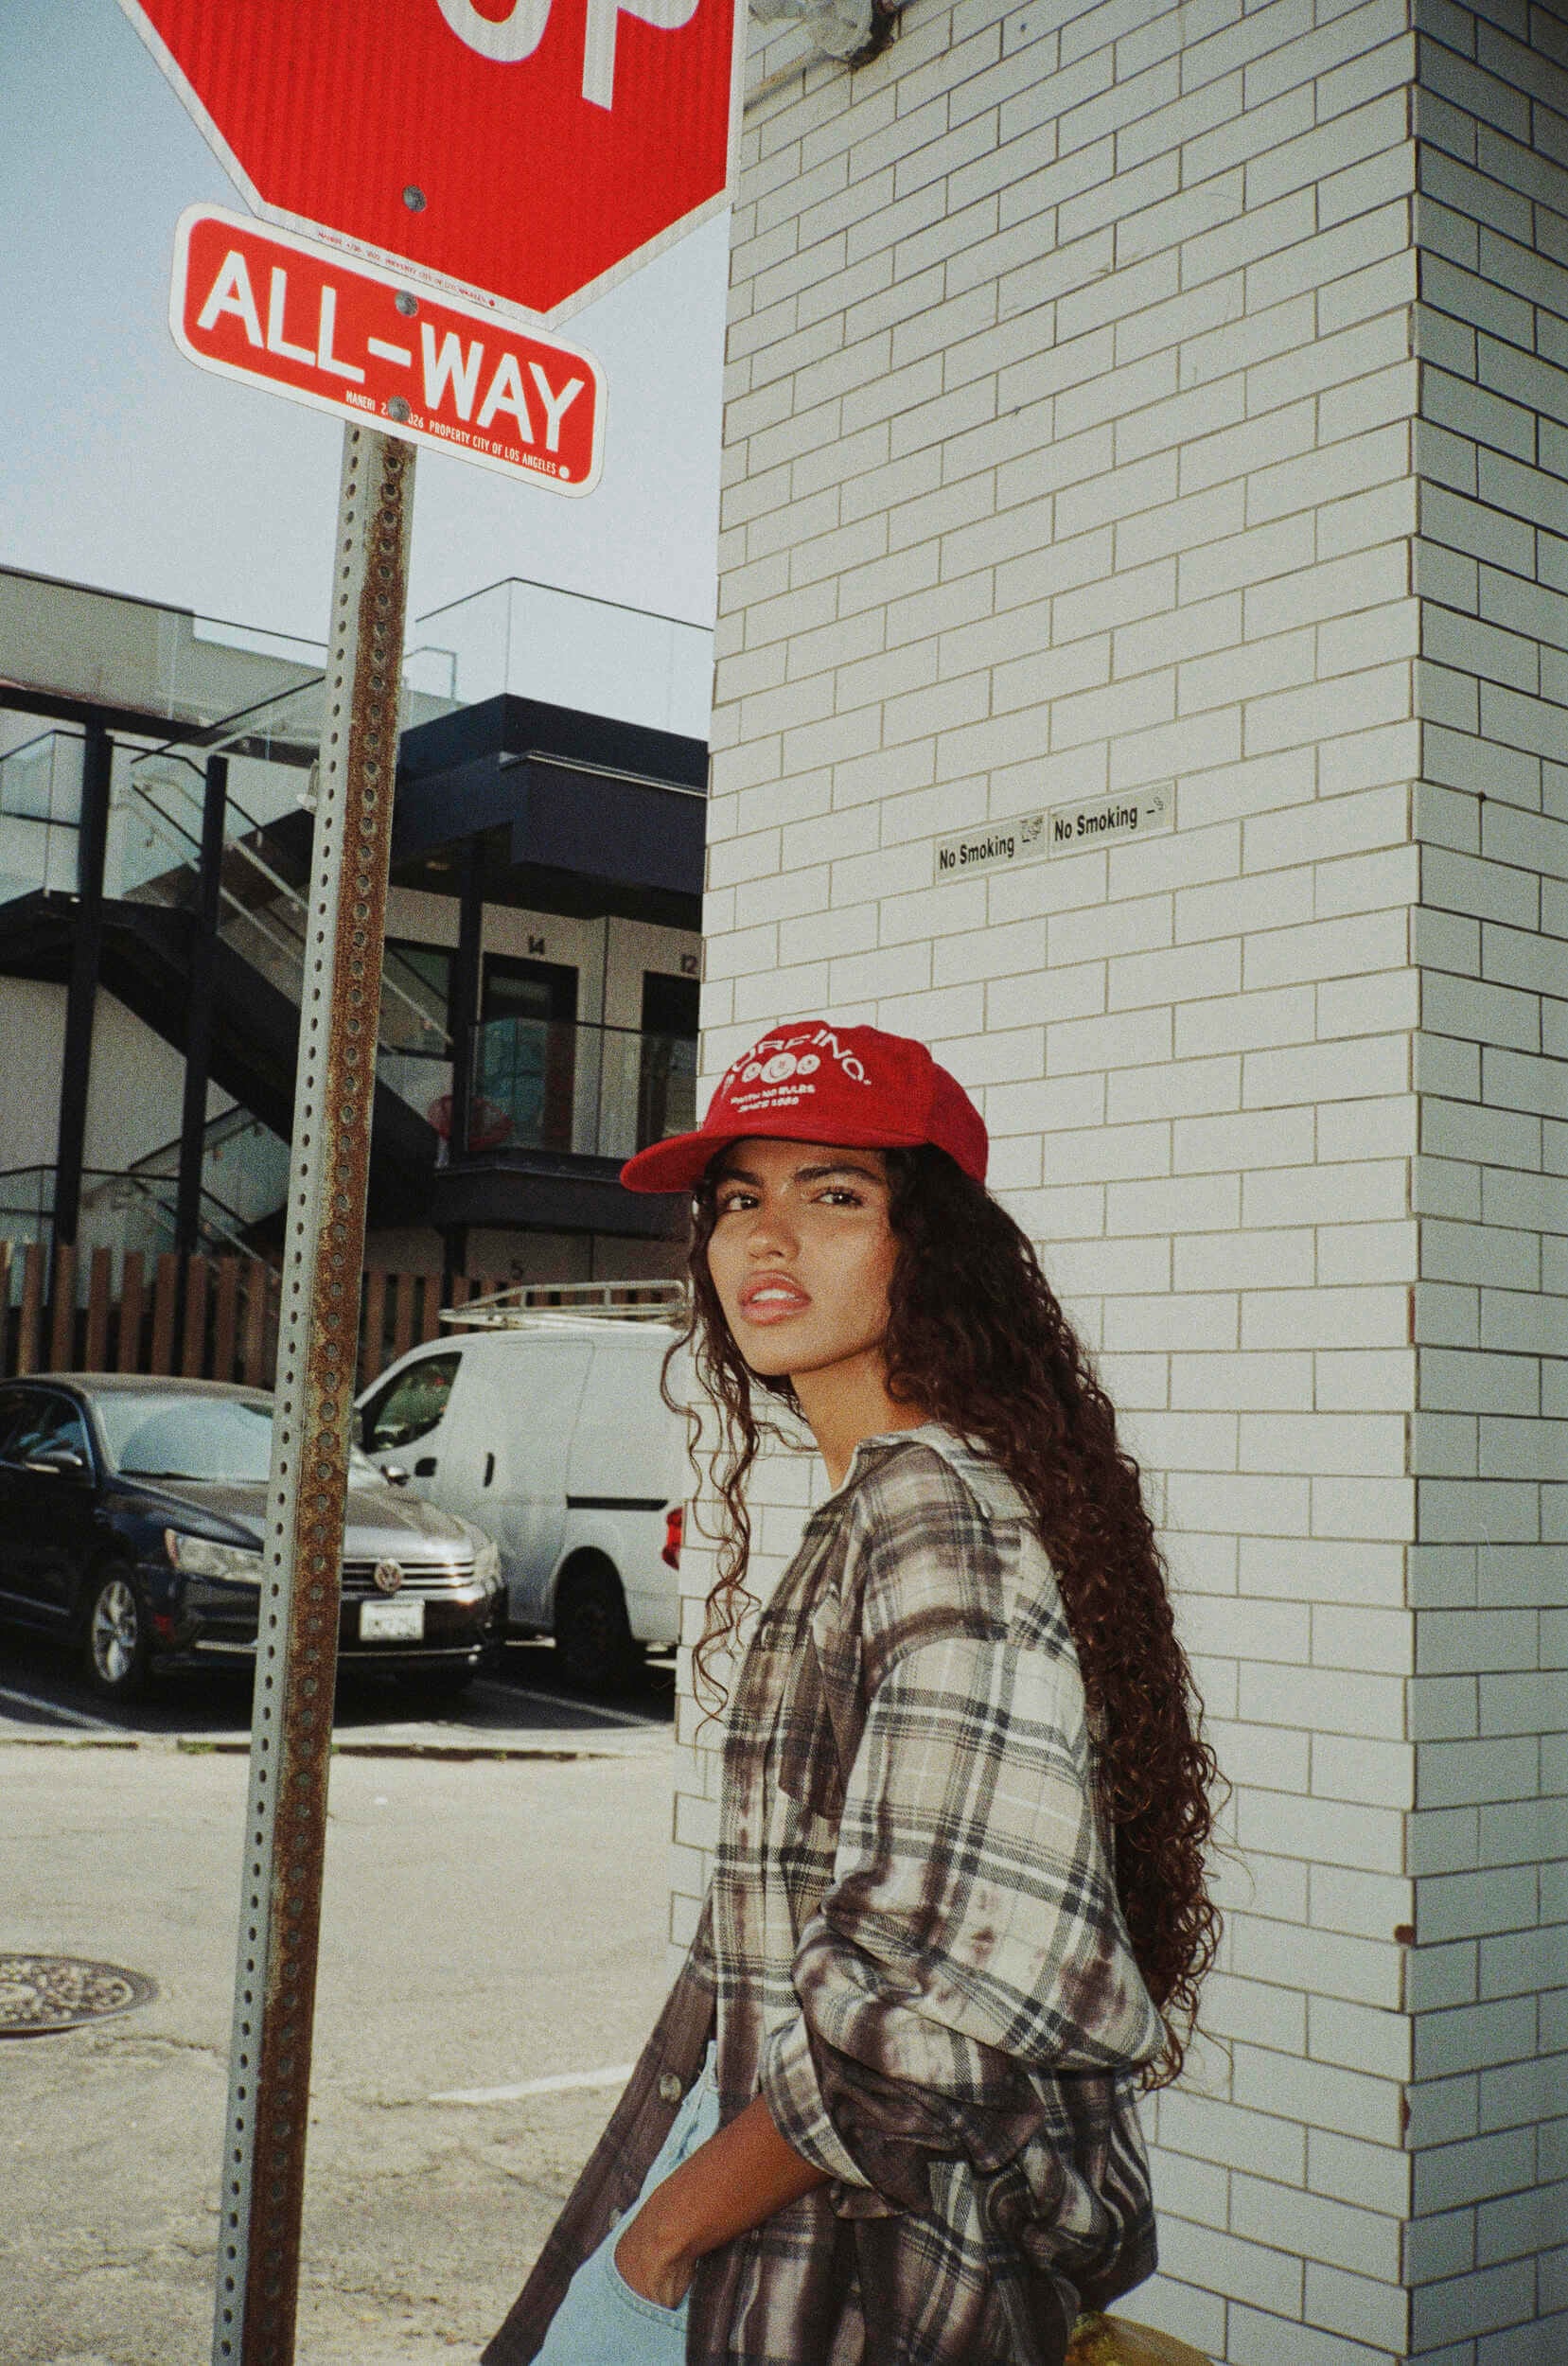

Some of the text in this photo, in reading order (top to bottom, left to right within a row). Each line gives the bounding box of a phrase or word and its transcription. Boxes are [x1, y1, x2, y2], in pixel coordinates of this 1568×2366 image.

[197, 251, 585, 452] ALL-WAY
[345, 390, 376, 411] MANERI
[430, 419, 470, 444] PROPERTY
[472, 435, 489, 451] CITY
[492, 442, 503, 455] OF
[504, 447, 520, 462] LOS
[522, 453, 556, 475] ANGELES
[1054, 805, 1138, 842] No Smoking
[940, 836, 1015, 871] No Smoking
[528, 935, 546, 955] 14
